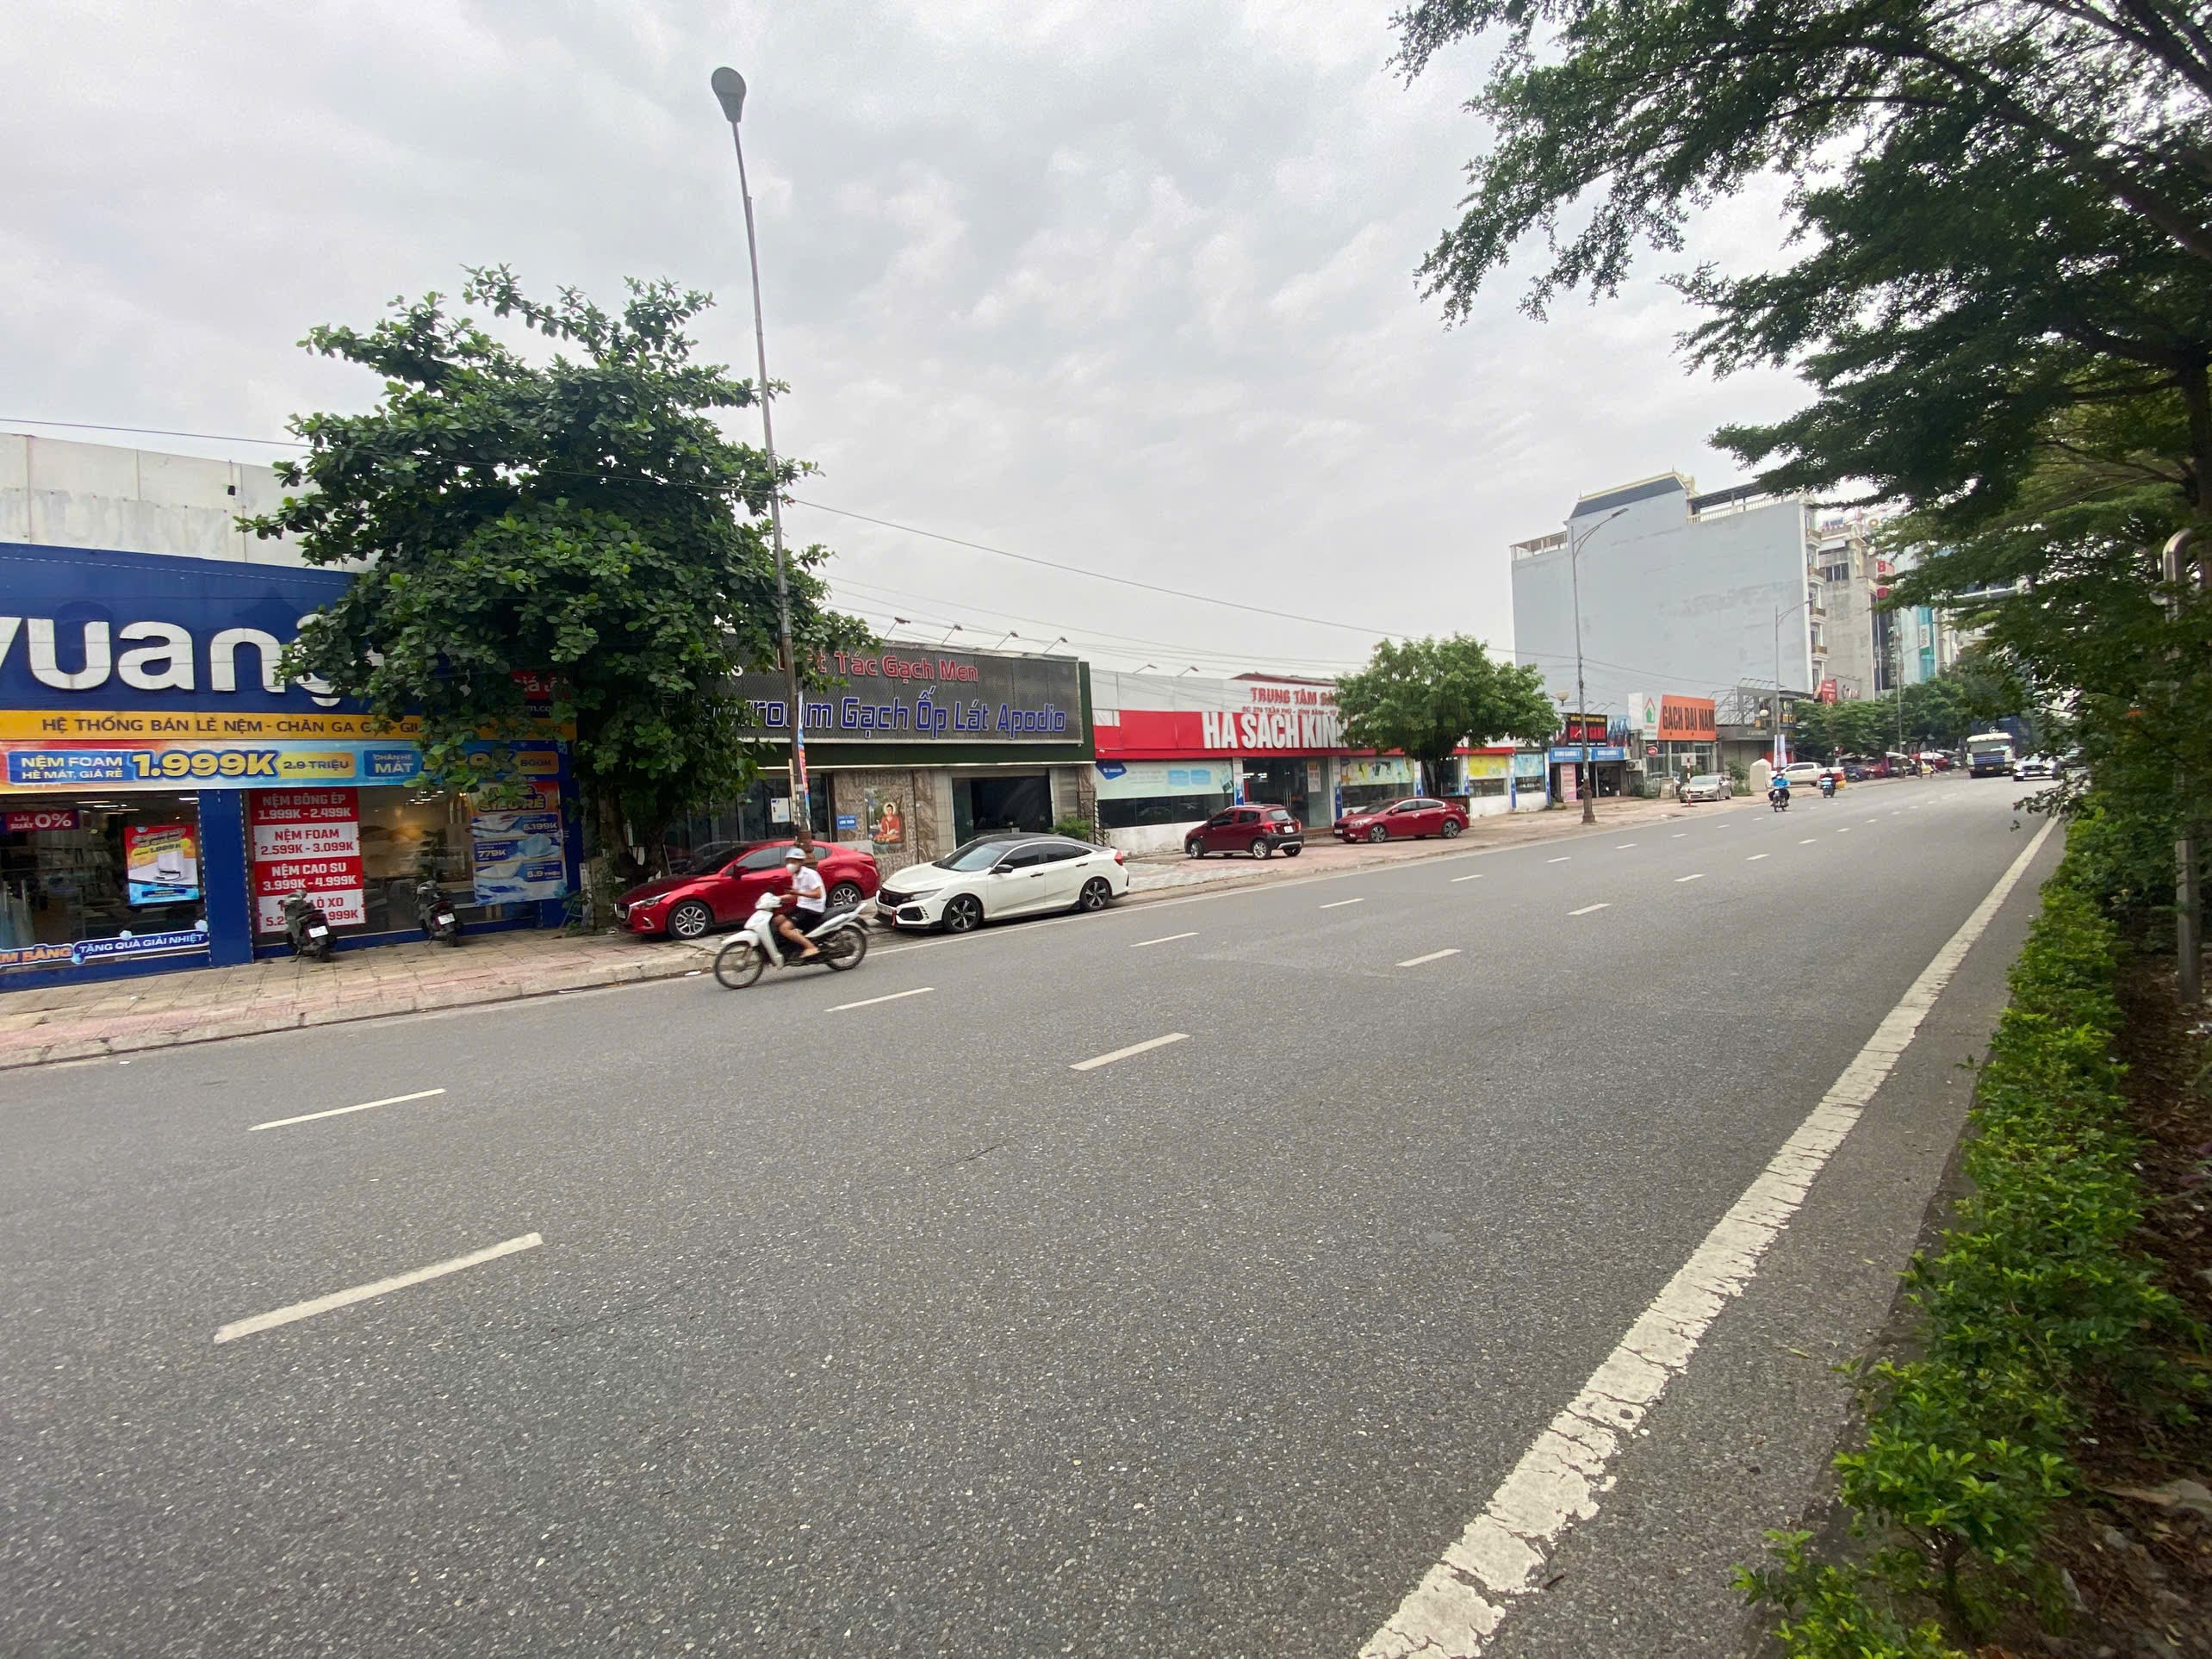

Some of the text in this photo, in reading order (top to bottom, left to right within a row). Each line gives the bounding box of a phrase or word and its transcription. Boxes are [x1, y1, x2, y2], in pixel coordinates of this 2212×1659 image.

[834, 649, 878, 676] Tác
[882, 656, 934, 685] Gạch
[939, 660, 979, 681] Men
[1251, 687, 1290, 703] TRUNG
[1294, 688, 1317, 705] TÂM
[840, 696, 910, 738] Gạch
[916, 686, 948, 738] Ốp
[954, 699, 989, 731] Lát
[996, 703, 1066, 739] Apodio
[42, 718, 67, 733] HỆ
[75, 715, 143, 731] THỐNG
[151, 718, 189, 731] BÁN
[196, 718, 217, 731] LẺ
[225, 719, 262, 734] NỆM
[276, 718, 324, 732] CHĂN
[332, 722, 355, 733] GA
[22, 755, 122, 769] NỆM FOAM
[133, 752, 276, 777] 1.999K
[308, 759, 350, 772] TRIỆU
[375, 760, 413, 774] MÁT
[79, 769, 101, 779] GIÁ
[263, 792, 346, 808] NỆM BÔNG ÉP
[35, 812, 71, 829] 0%
[258, 809, 301, 820] 1.999K
[310, 807, 351, 817] 2.499K
[275, 829, 339, 842] NỆM FOAM
[261, 844, 302, 855] 2.599K
[314, 842, 354, 853] 3.099K
[271, 862, 346, 878] NỆM CAO SU
[263, 879, 306, 891] 3.999K
[315, 875, 357, 886] 4.999K
[327, 897, 344, 907] XO
[79, 933, 205, 954] TẶNG QUÀ GIẢI NHIỆT
